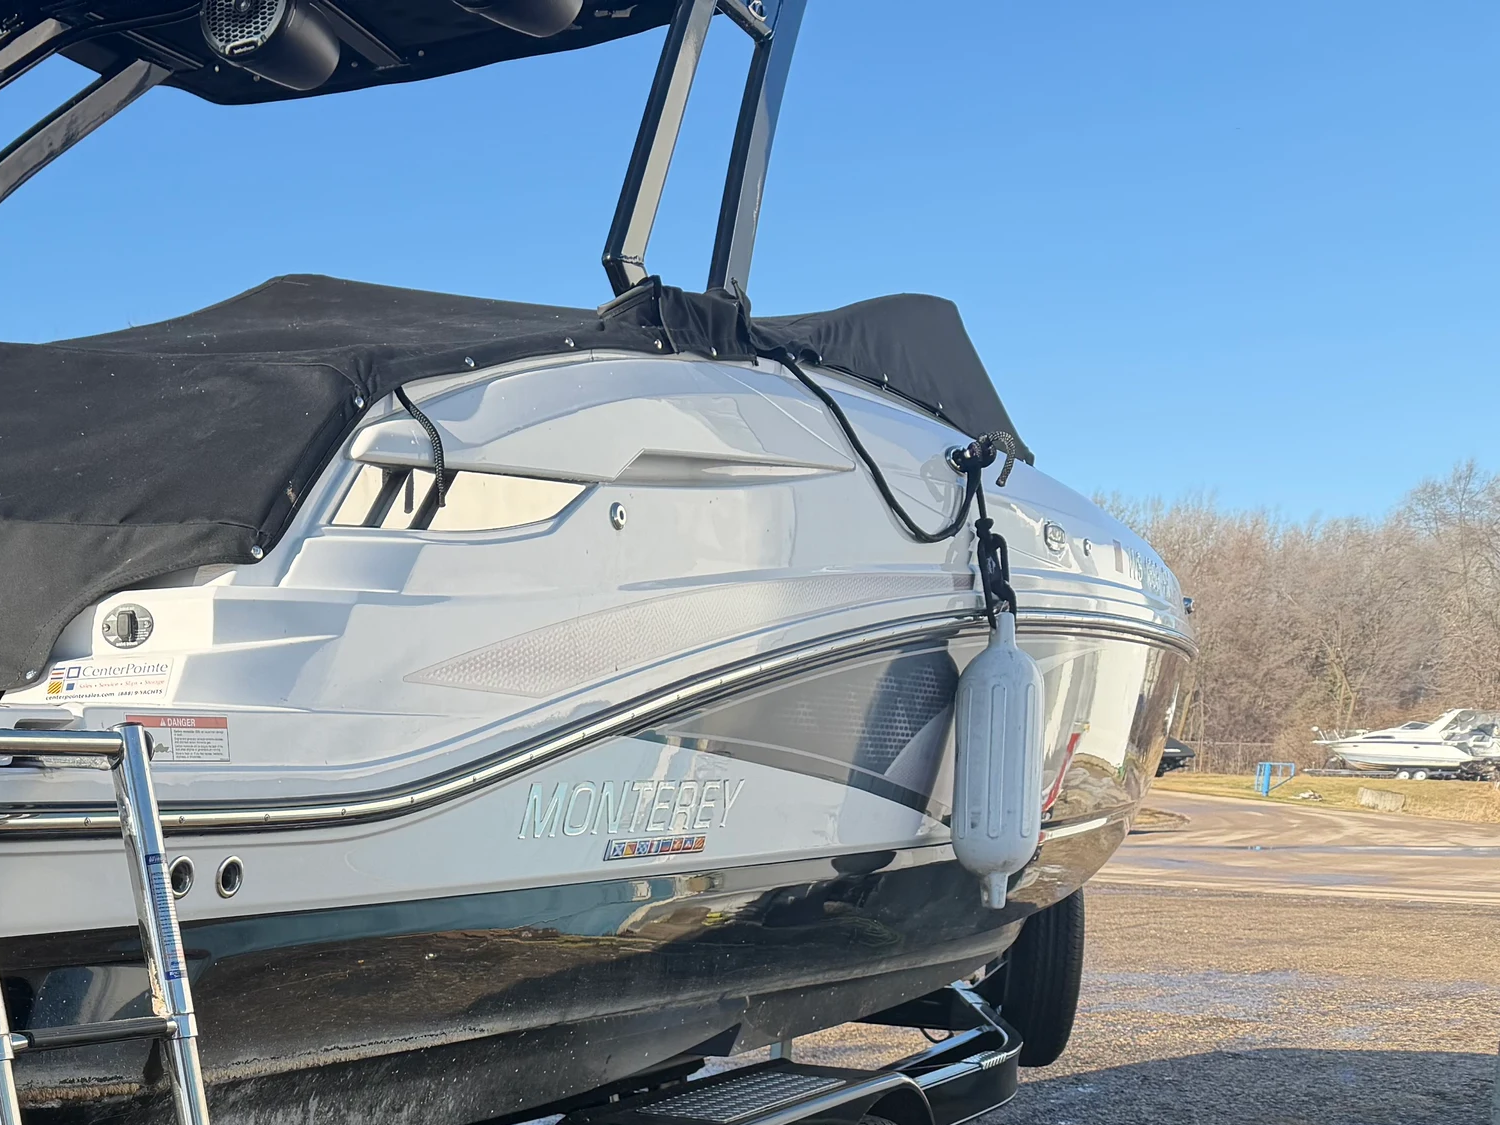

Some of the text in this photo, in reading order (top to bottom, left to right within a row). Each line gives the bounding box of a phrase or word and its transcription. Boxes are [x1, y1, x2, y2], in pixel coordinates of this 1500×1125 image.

[82, 662, 169, 678] CenterPointe
[45, 691, 115, 701] centerpointesales.com
[167, 717, 196, 727] DANGER
[517, 778, 746, 840] MONTEREY
